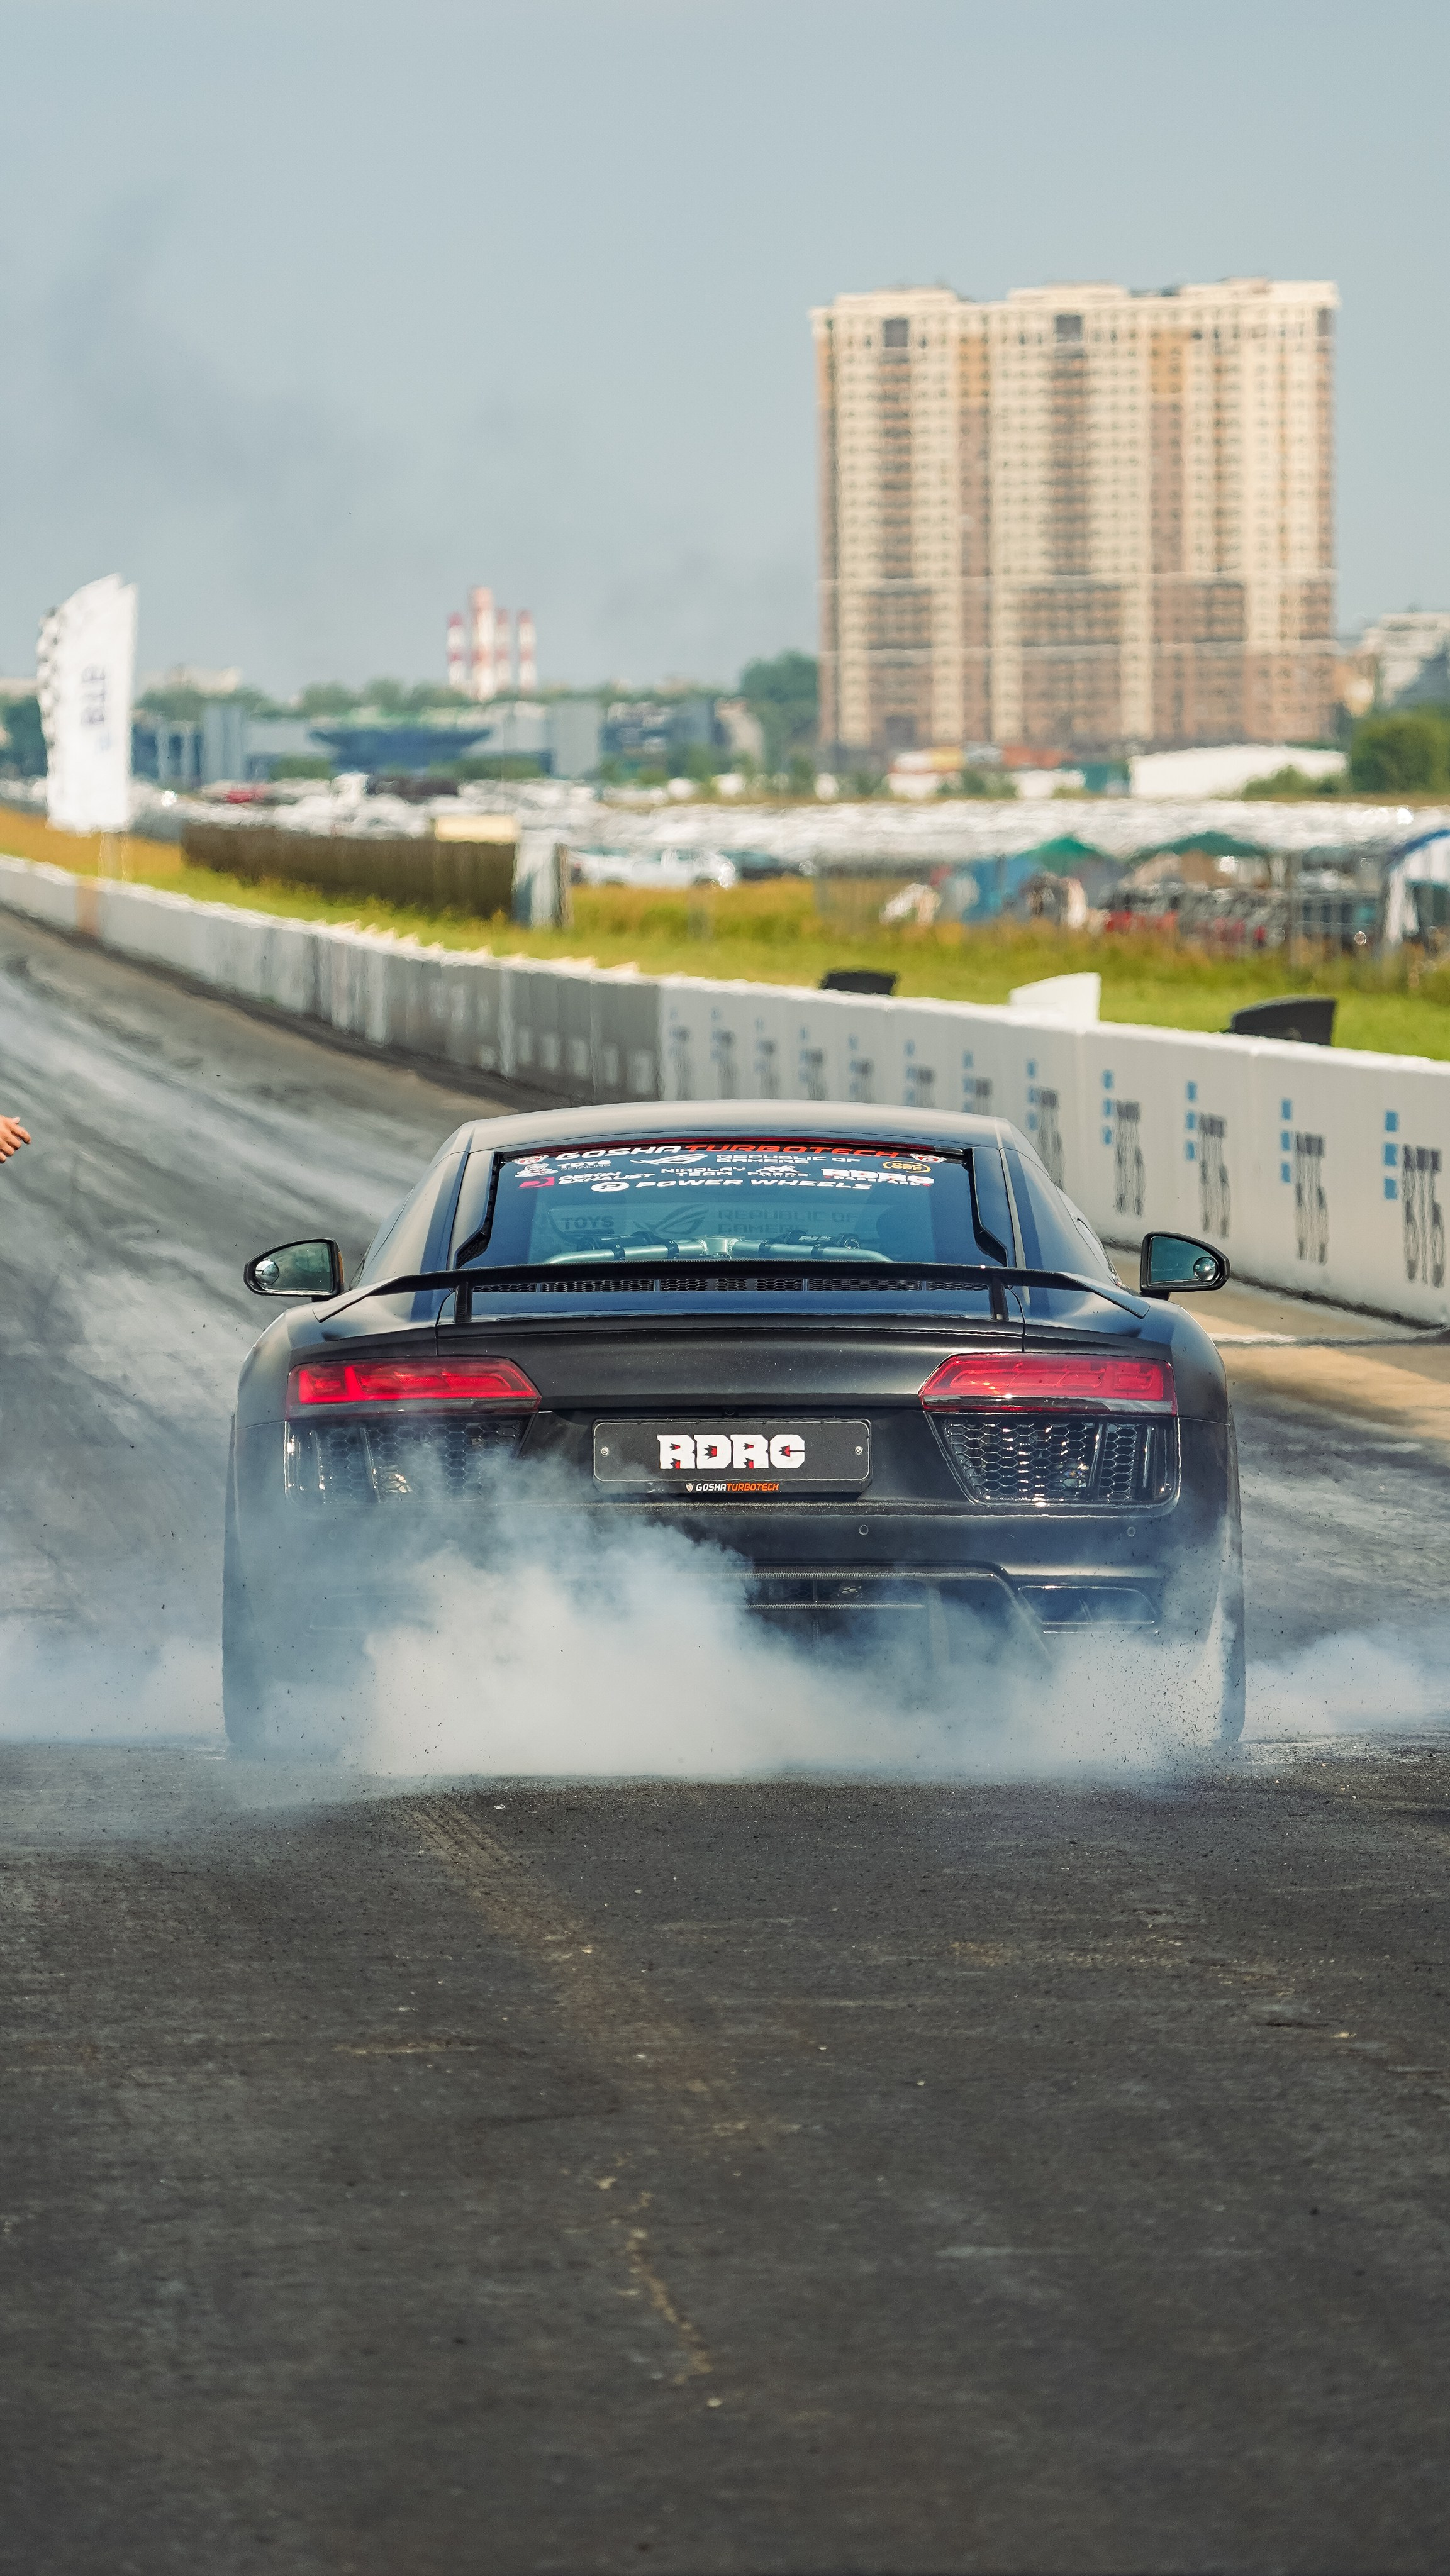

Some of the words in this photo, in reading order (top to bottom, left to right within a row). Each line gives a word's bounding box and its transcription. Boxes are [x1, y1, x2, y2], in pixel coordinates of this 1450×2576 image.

[557, 1160, 611, 1169] TOYS
[558, 1173, 655, 1185] EXHAUST
[635, 1179, 744, 1188] POWER
[750, 1179, 873, 1189] WHEELS
[561, 1215, 615, 1230] TOYS
[657, 1434, 805, 1470] RDRC
